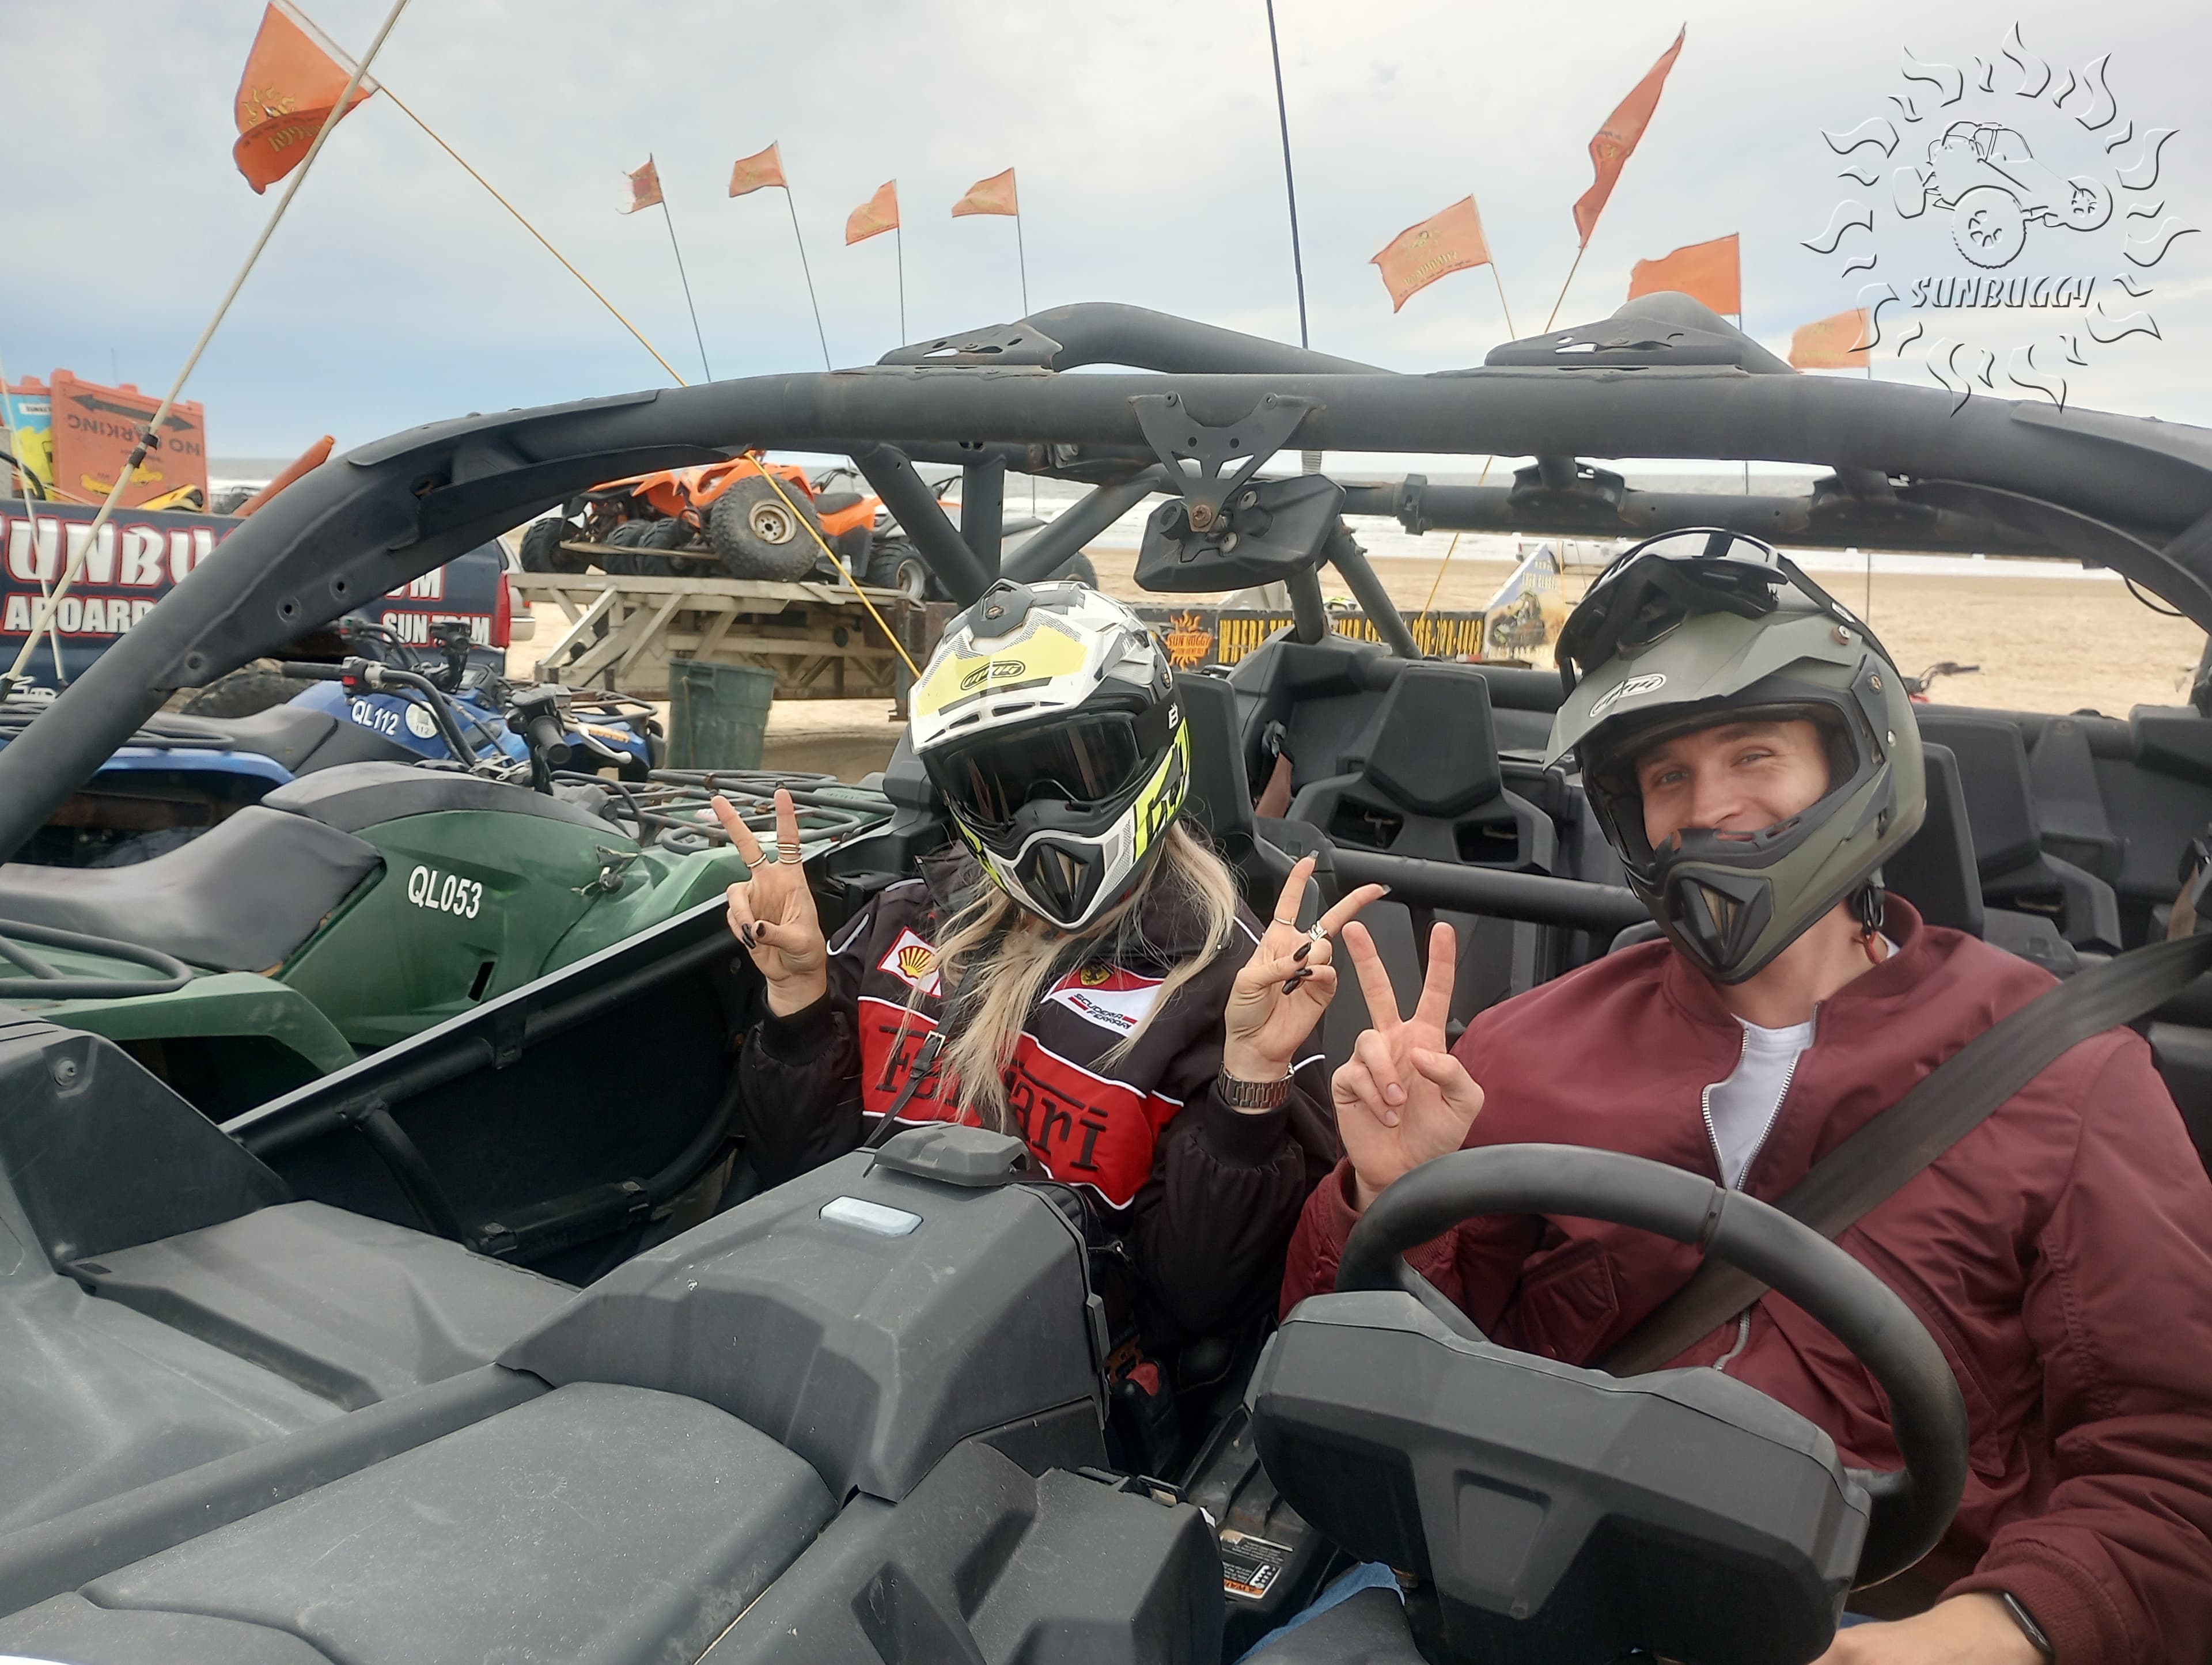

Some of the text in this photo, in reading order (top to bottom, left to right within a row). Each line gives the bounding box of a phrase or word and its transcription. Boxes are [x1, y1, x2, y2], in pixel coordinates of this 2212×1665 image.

[67, 414, 162, 449] RKING
[168, 438, 201, 457] NO
[0, 514, 215, 586] UNBU
[382, 612, 429, 644] SUN
[1168, 635, 1184, 646] SUN
[351, 700, 399, 736] QL112
[408, 865, 482, 919] QL053
[1074, 993, 1124, 1019] SCUDERIA
[1086, 1011, 1132, 1030] FERRARI
